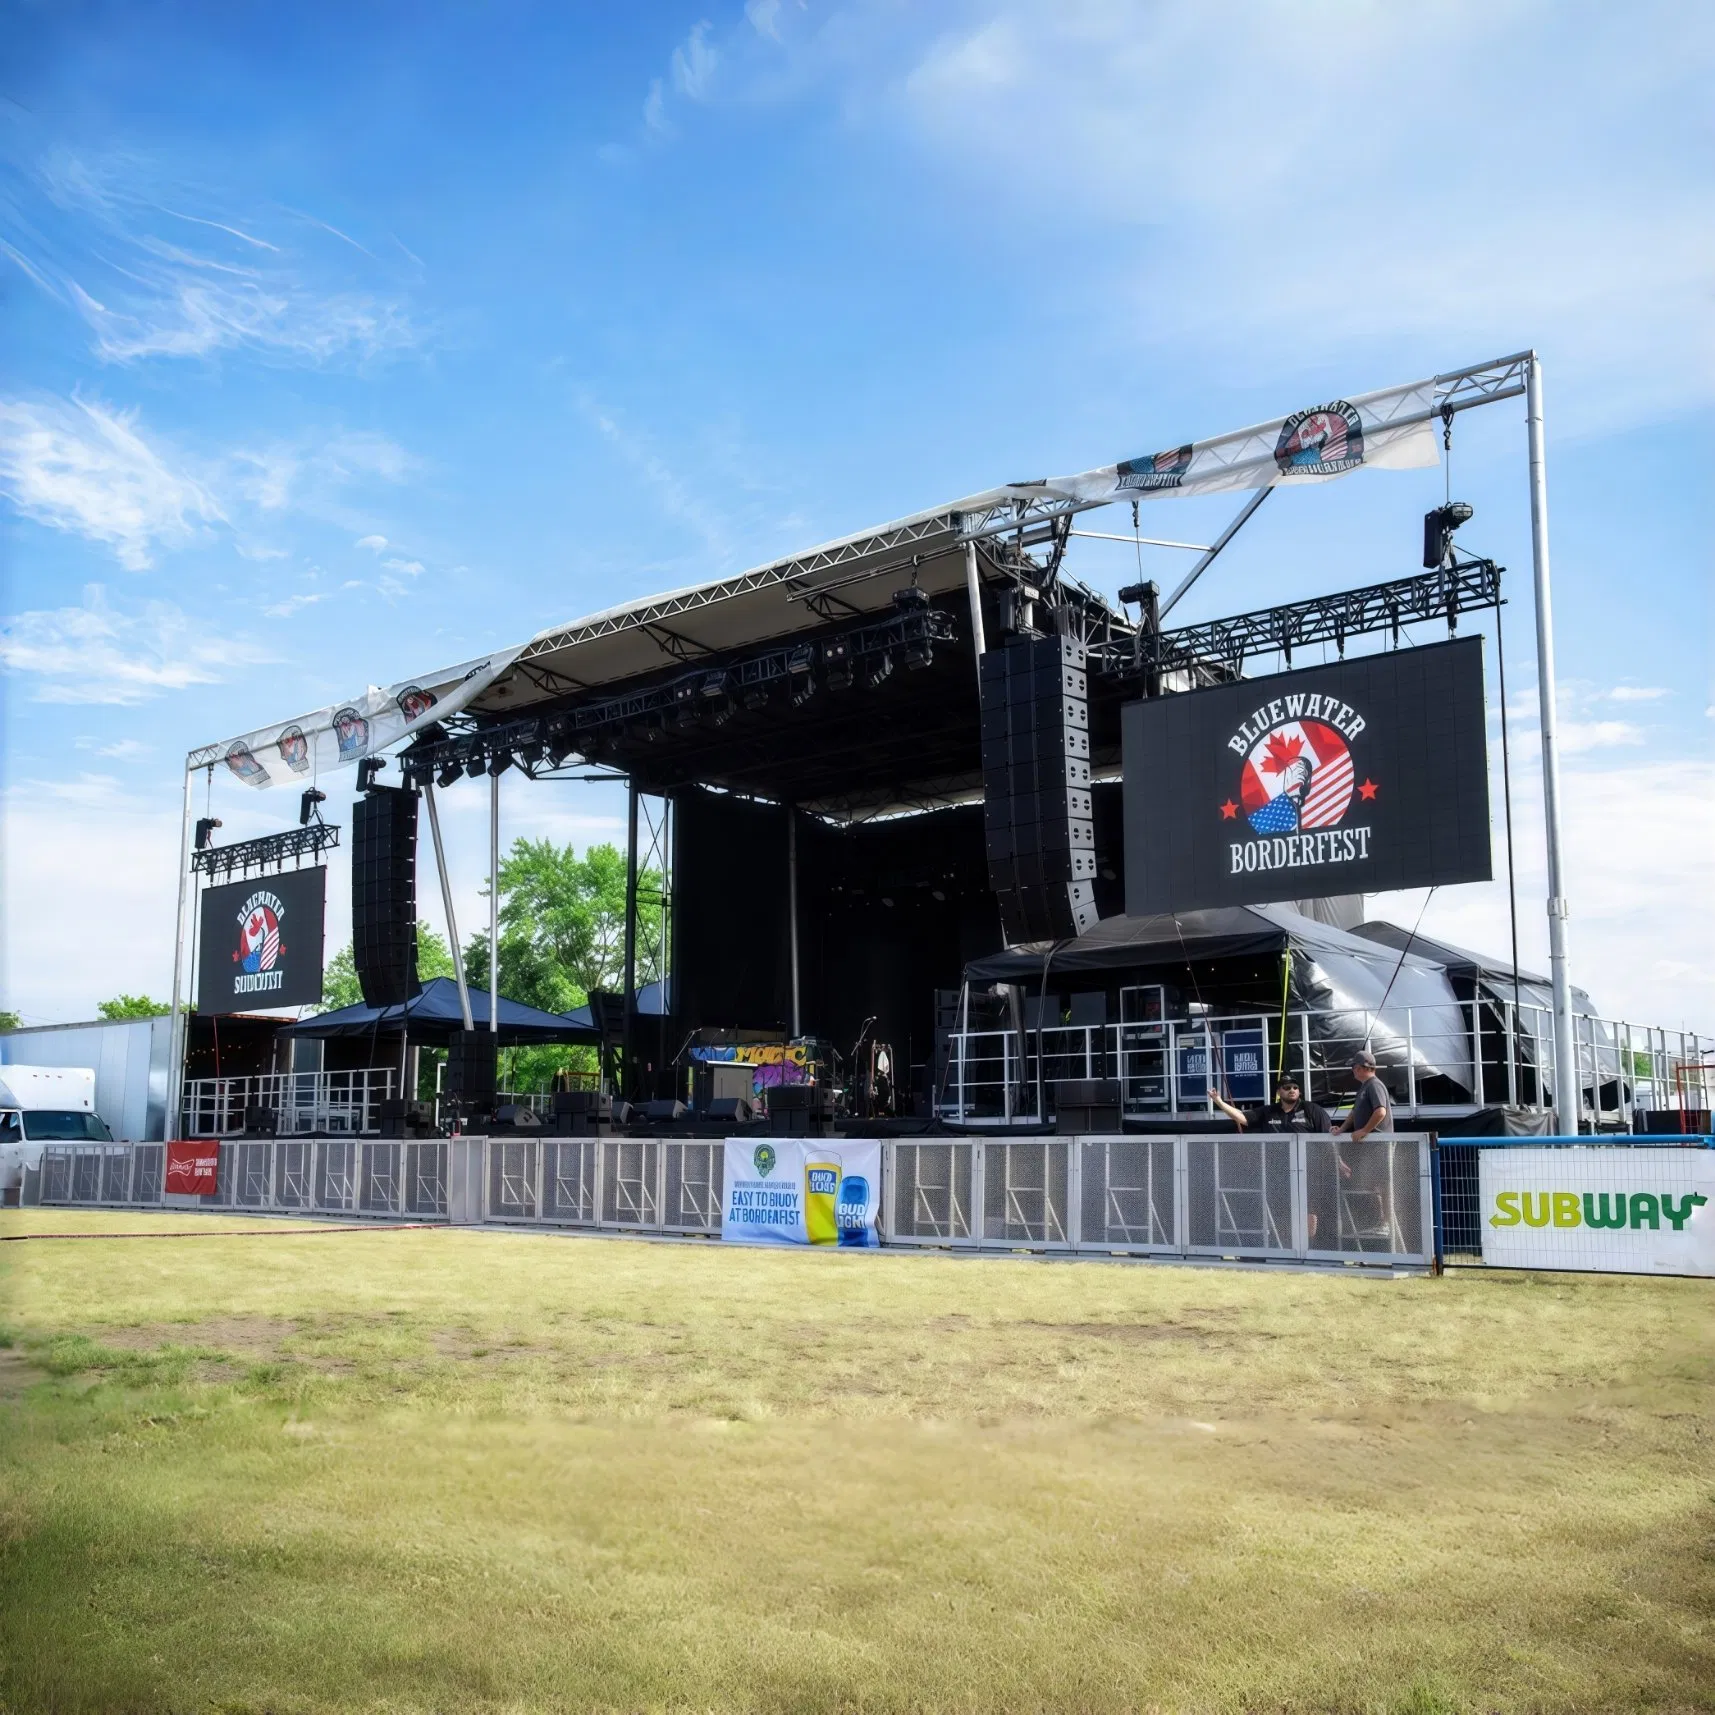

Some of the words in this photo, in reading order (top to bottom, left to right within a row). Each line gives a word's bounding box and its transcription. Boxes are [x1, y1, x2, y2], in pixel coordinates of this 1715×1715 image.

[1228, 693, 1366, 756] BLUEWATER
[1230, 827, 1371, 874] BORDERFEST
[729, 1208, 741, 1222] AT
[1489, 1191, 1708, 1230] SUBWAY
